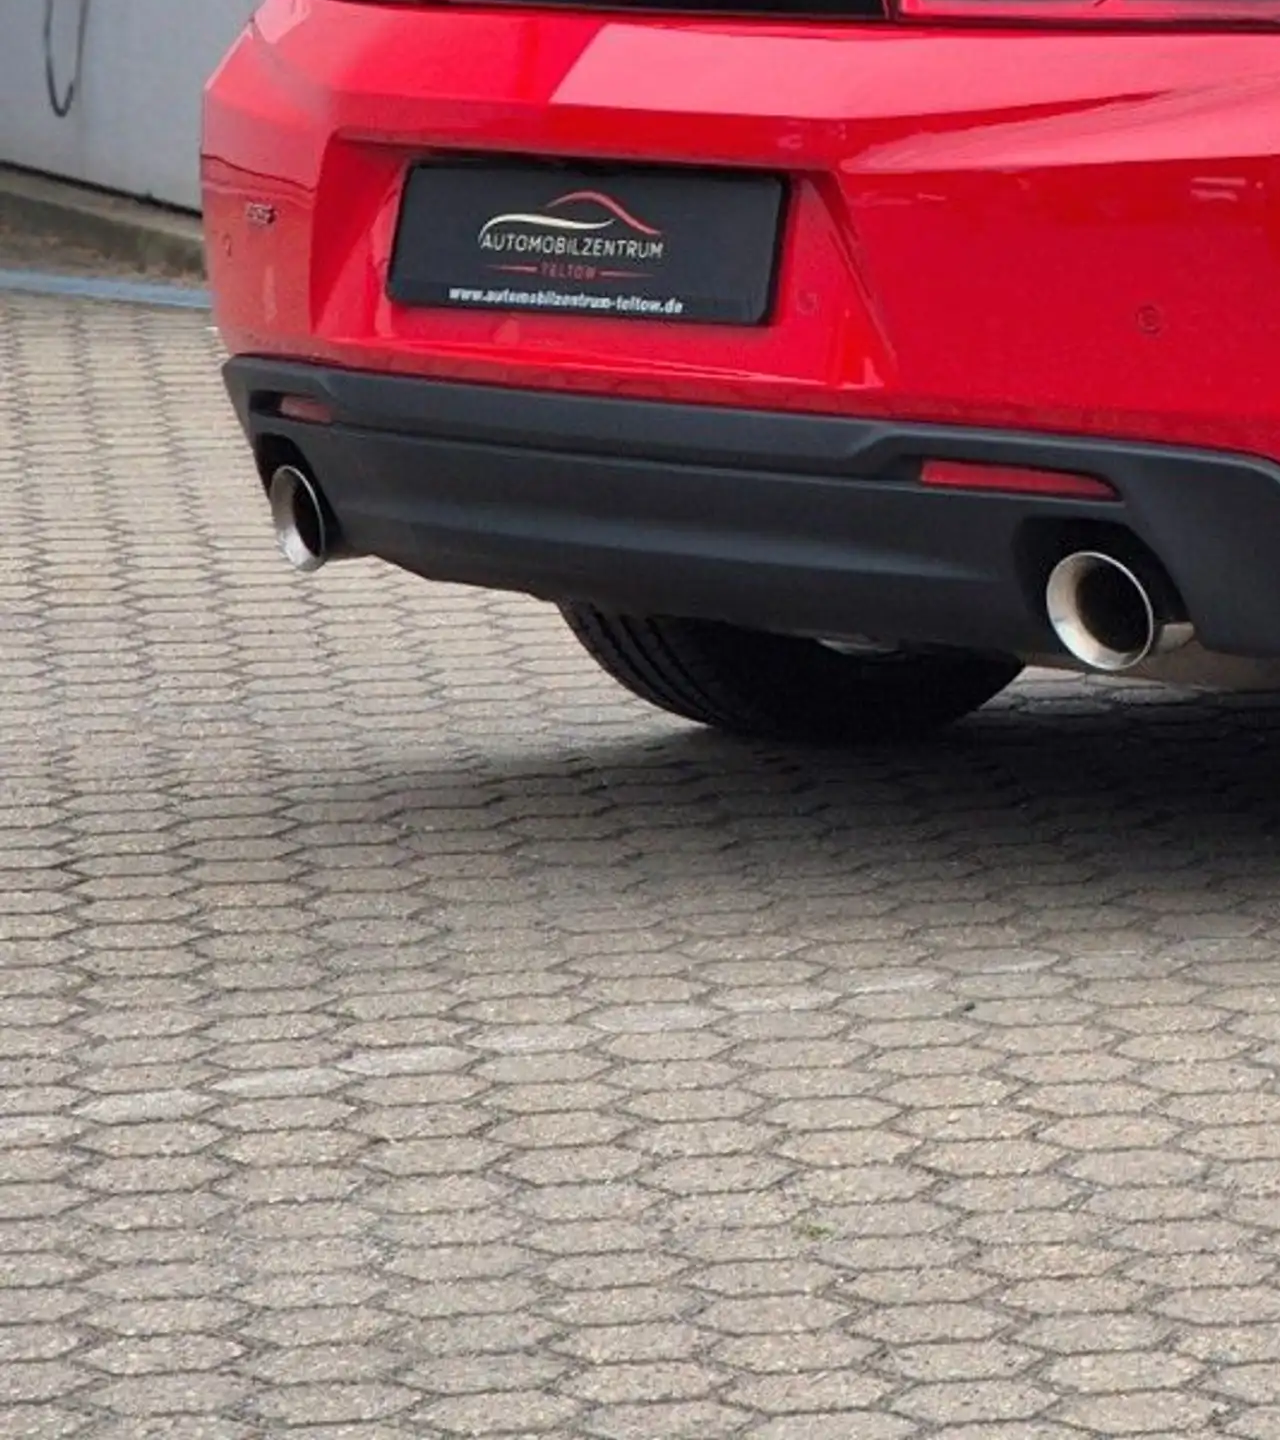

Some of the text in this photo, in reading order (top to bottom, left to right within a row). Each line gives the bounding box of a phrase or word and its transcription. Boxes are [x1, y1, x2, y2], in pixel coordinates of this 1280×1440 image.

[480, 232, 665, 259] AUTOMOBILZENTRUM
[540, 261, 598, 280] TELTOW
[449, 286, 684, 314] www.automobilzentrum-teltow.de
